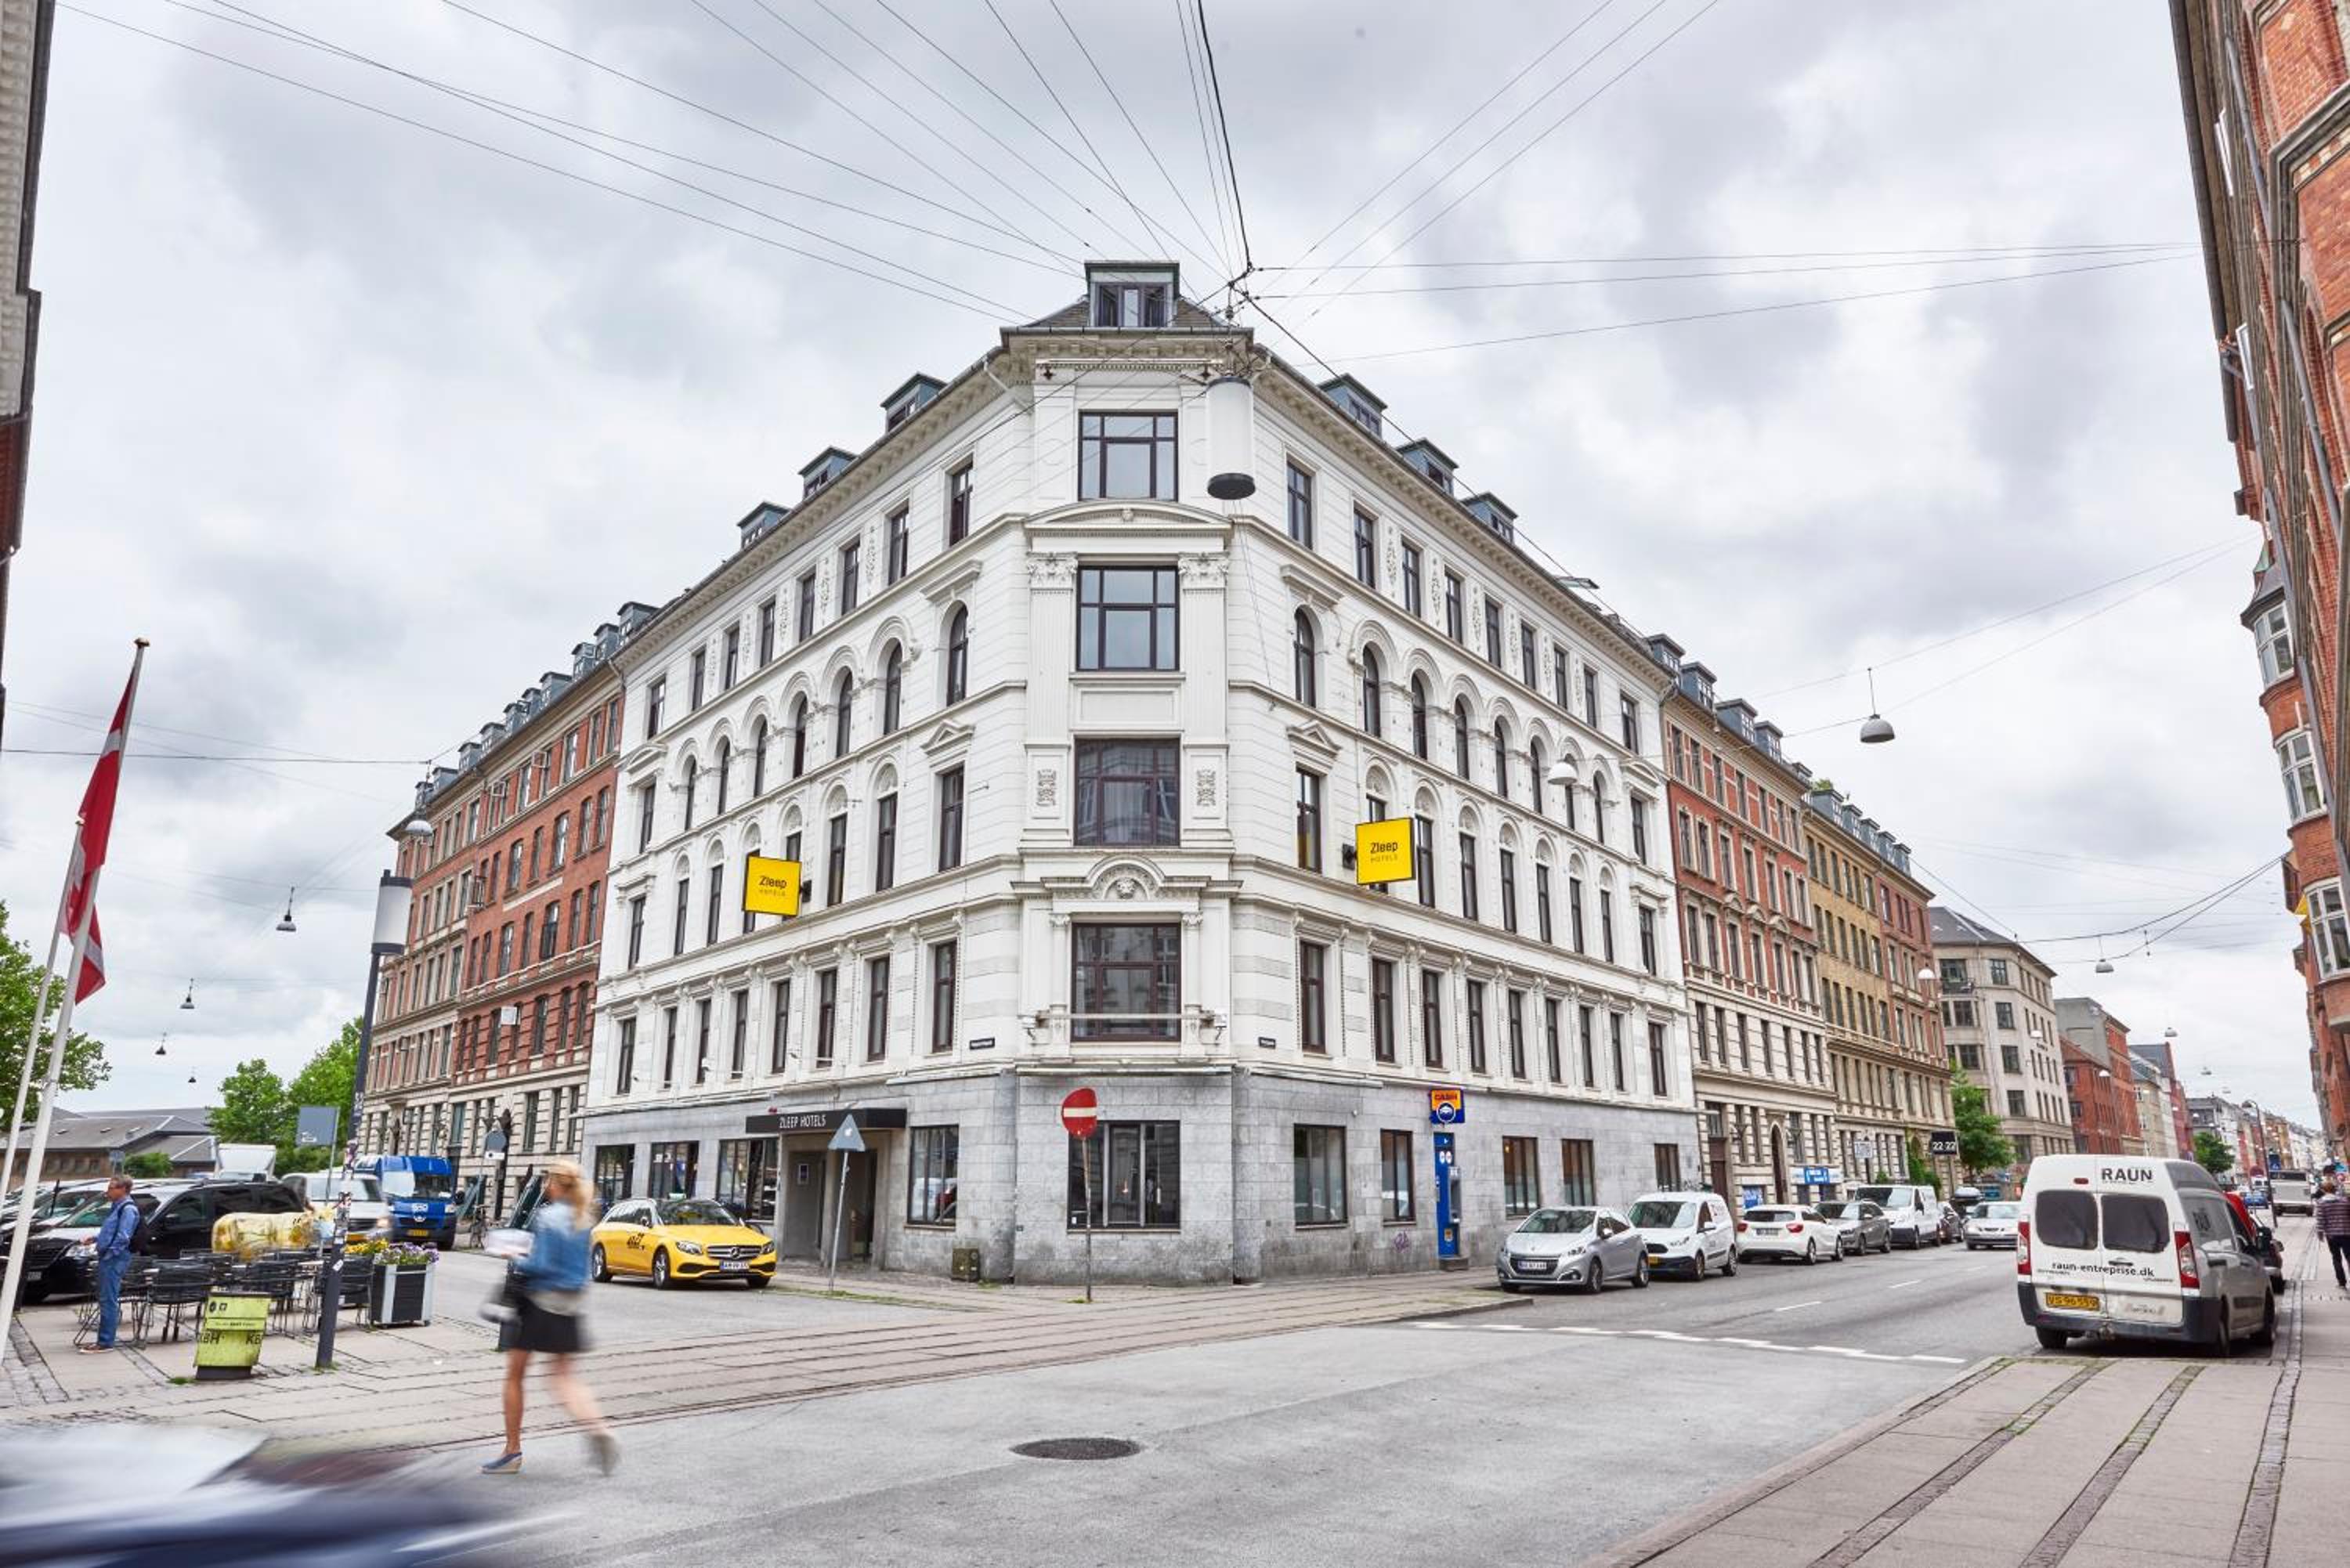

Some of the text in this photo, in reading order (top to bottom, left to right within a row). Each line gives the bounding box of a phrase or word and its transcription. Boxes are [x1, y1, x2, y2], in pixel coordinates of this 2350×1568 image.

[1370, 841, 1398, 854] Zleep
[758, 875, 787, 890] Zleep
[779, 1115, 827, 1129] ZLEEP HOTELS
[2101, 1167, 2153, 1182] RAUN
[2052, 1261, 2155, 1277] raun-entreprise.dk
